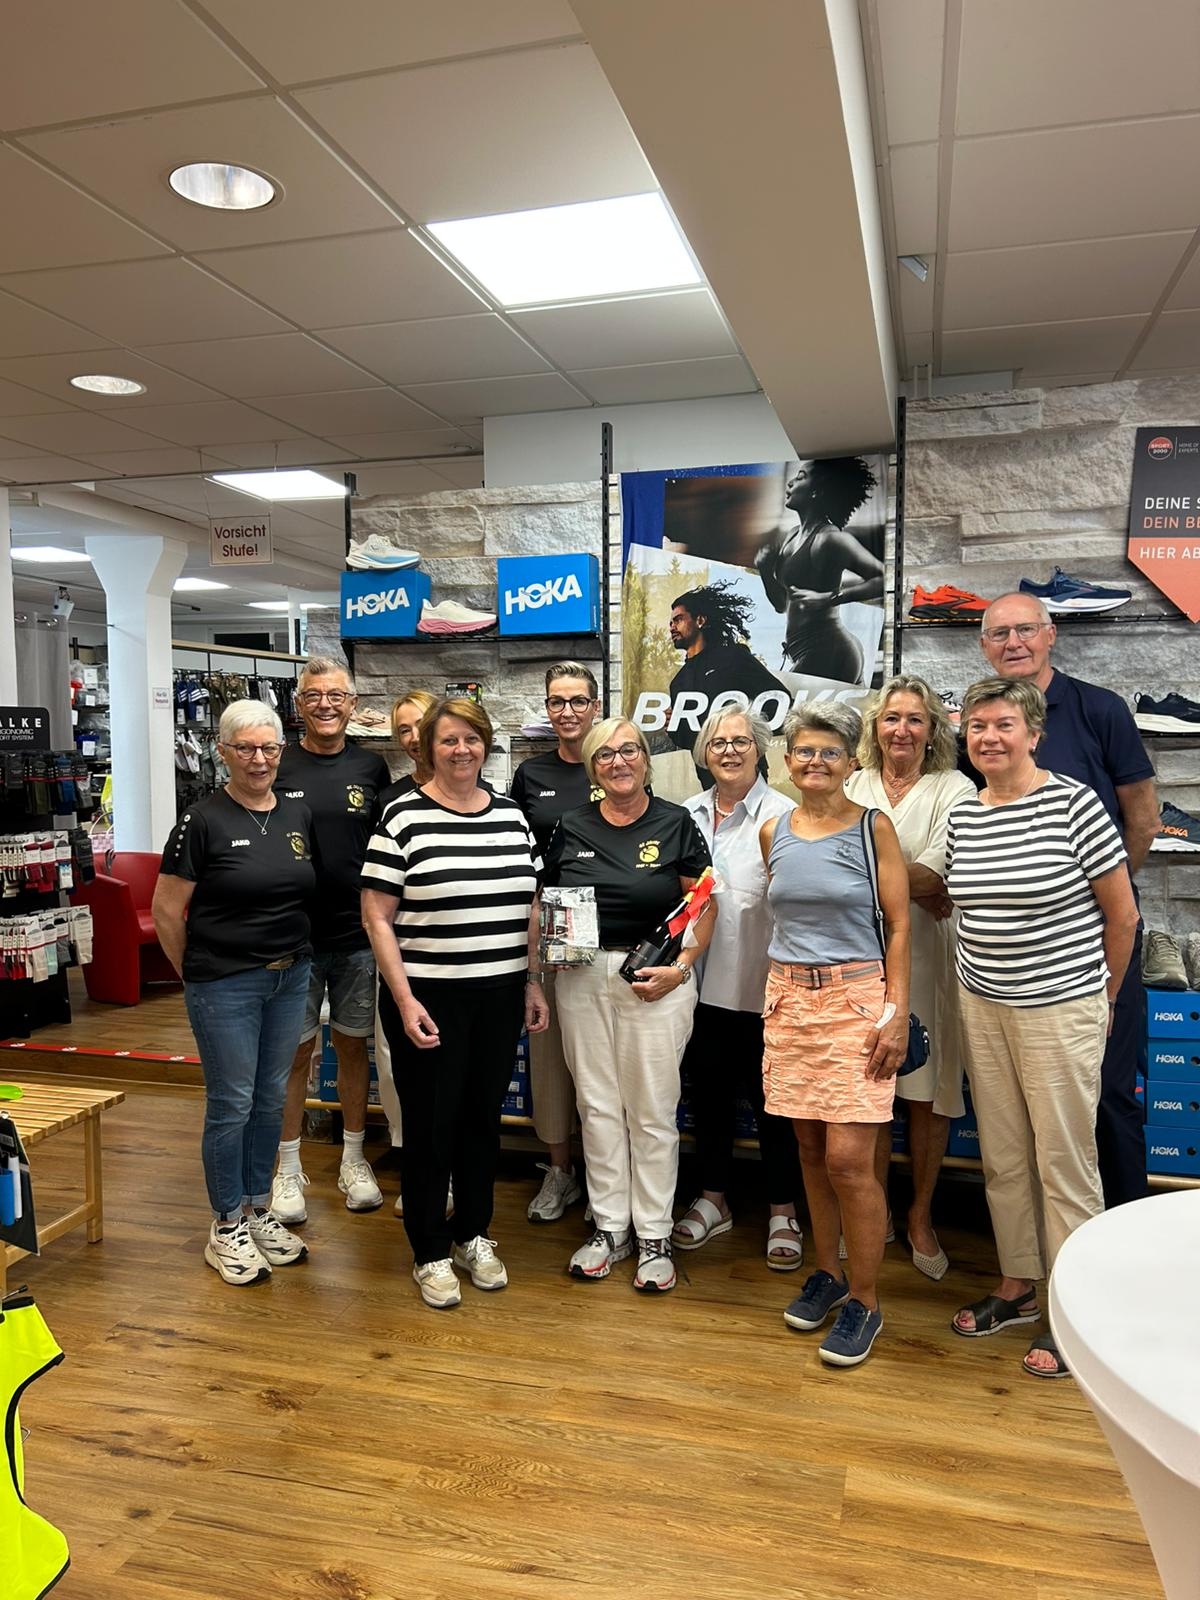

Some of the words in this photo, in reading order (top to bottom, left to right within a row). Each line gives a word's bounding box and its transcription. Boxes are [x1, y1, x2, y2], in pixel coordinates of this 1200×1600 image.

[1144, 497, 1191, 510] DEINE
[1143, 516, 1179, 529] DEIN
[214, 524, 266, 539] Vorsicht
[222, 543, 258, 557] Stufe!
[1139, 546, 1176, 559] HIER
[1181, 546, 1200, 559] AB
[504, 574, 583, 616] HOKA
[345, 587, 411, 620] HOKA
[1160, 824, 1189, 838] HOKA
[231, 839, 251, 848] JAKO
[1154, 1012, 1184, 1022] HOKA
[1155, 1054, 1185, 1064] HOKA
[1153, 1101, 1183, 1111] HOKA
[1150, 1146, 1180, 1156] HOKA
